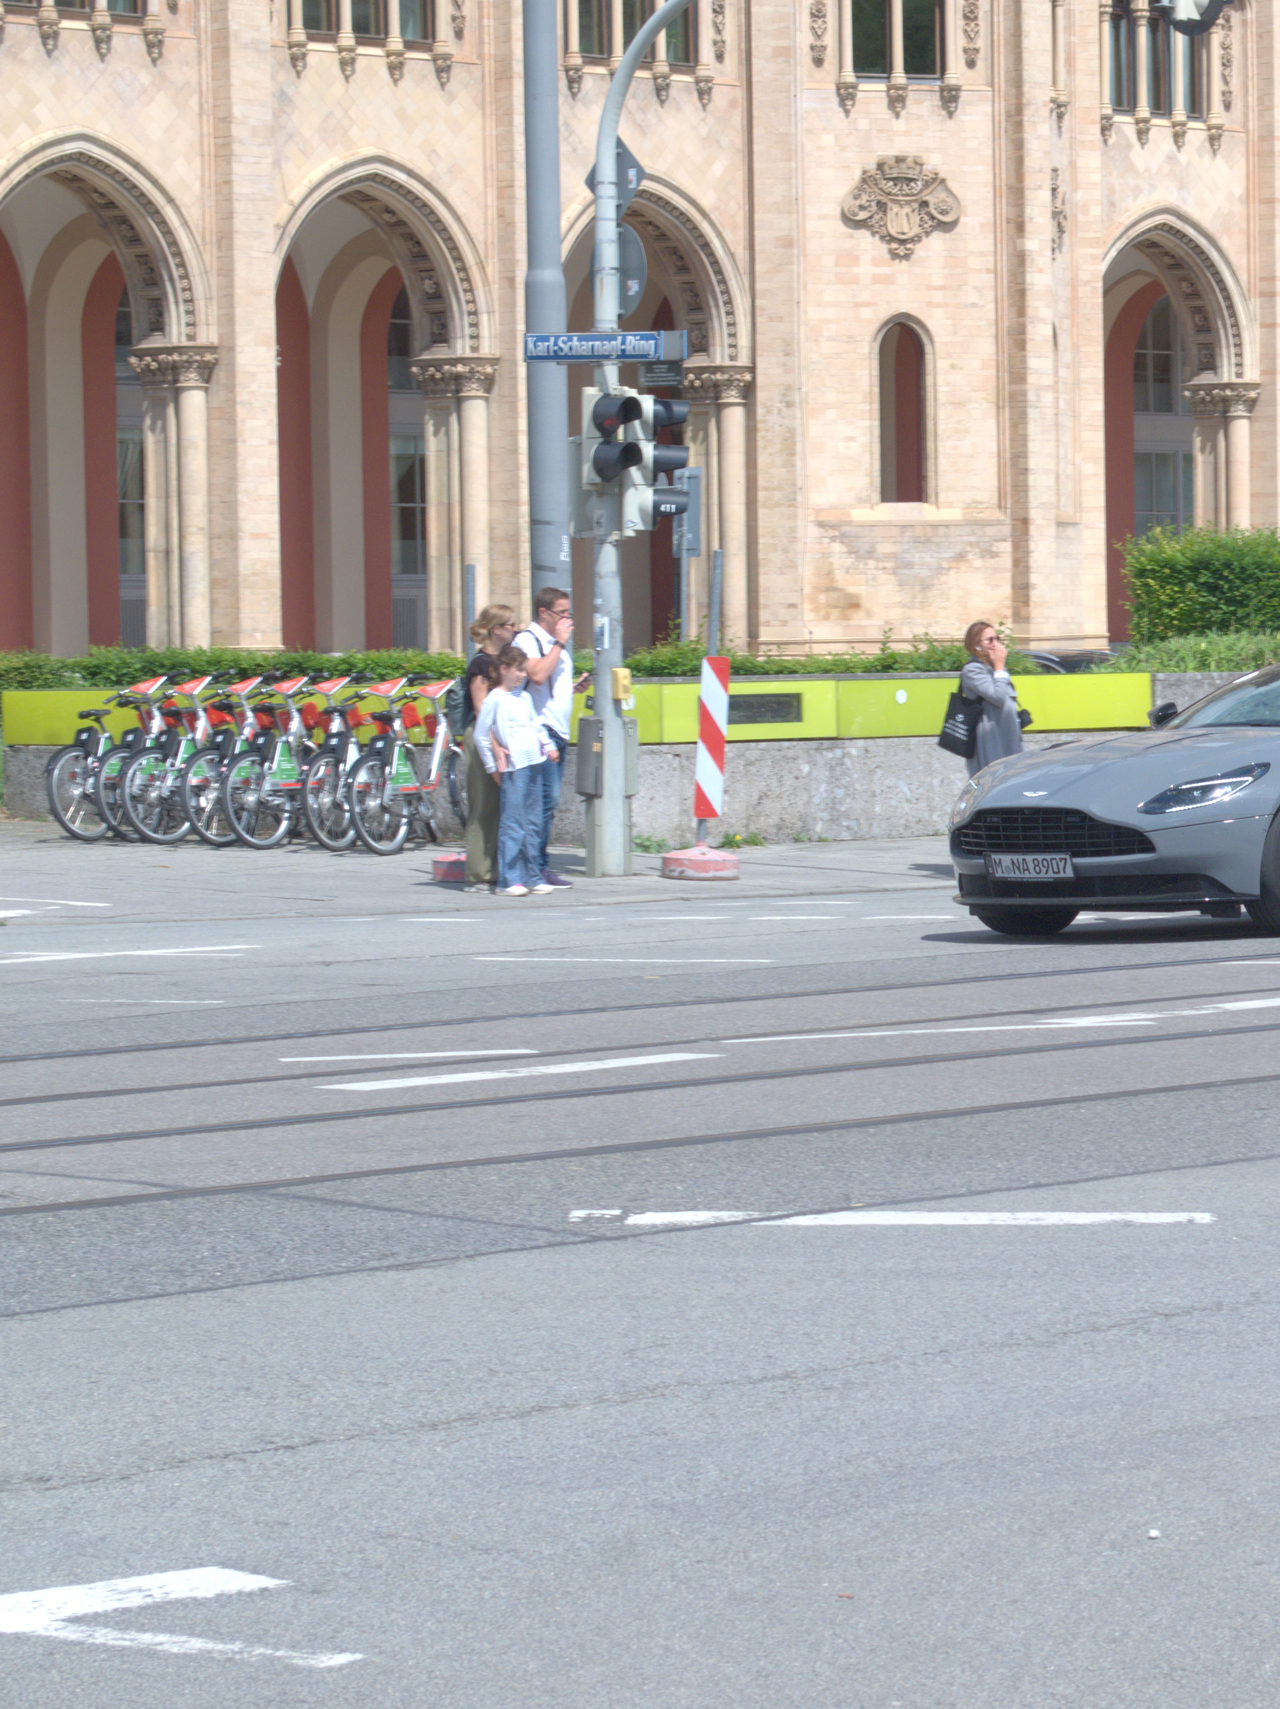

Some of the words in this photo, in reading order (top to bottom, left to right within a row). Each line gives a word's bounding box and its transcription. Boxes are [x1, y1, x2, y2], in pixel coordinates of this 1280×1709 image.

[526, 335, 656, 358] Karl-Scharnagl-Ring
[993, 857, 1005, 875] M
[1010, 857, 1030, 875] NA
[1033, 857, 1068, 875] 8907
